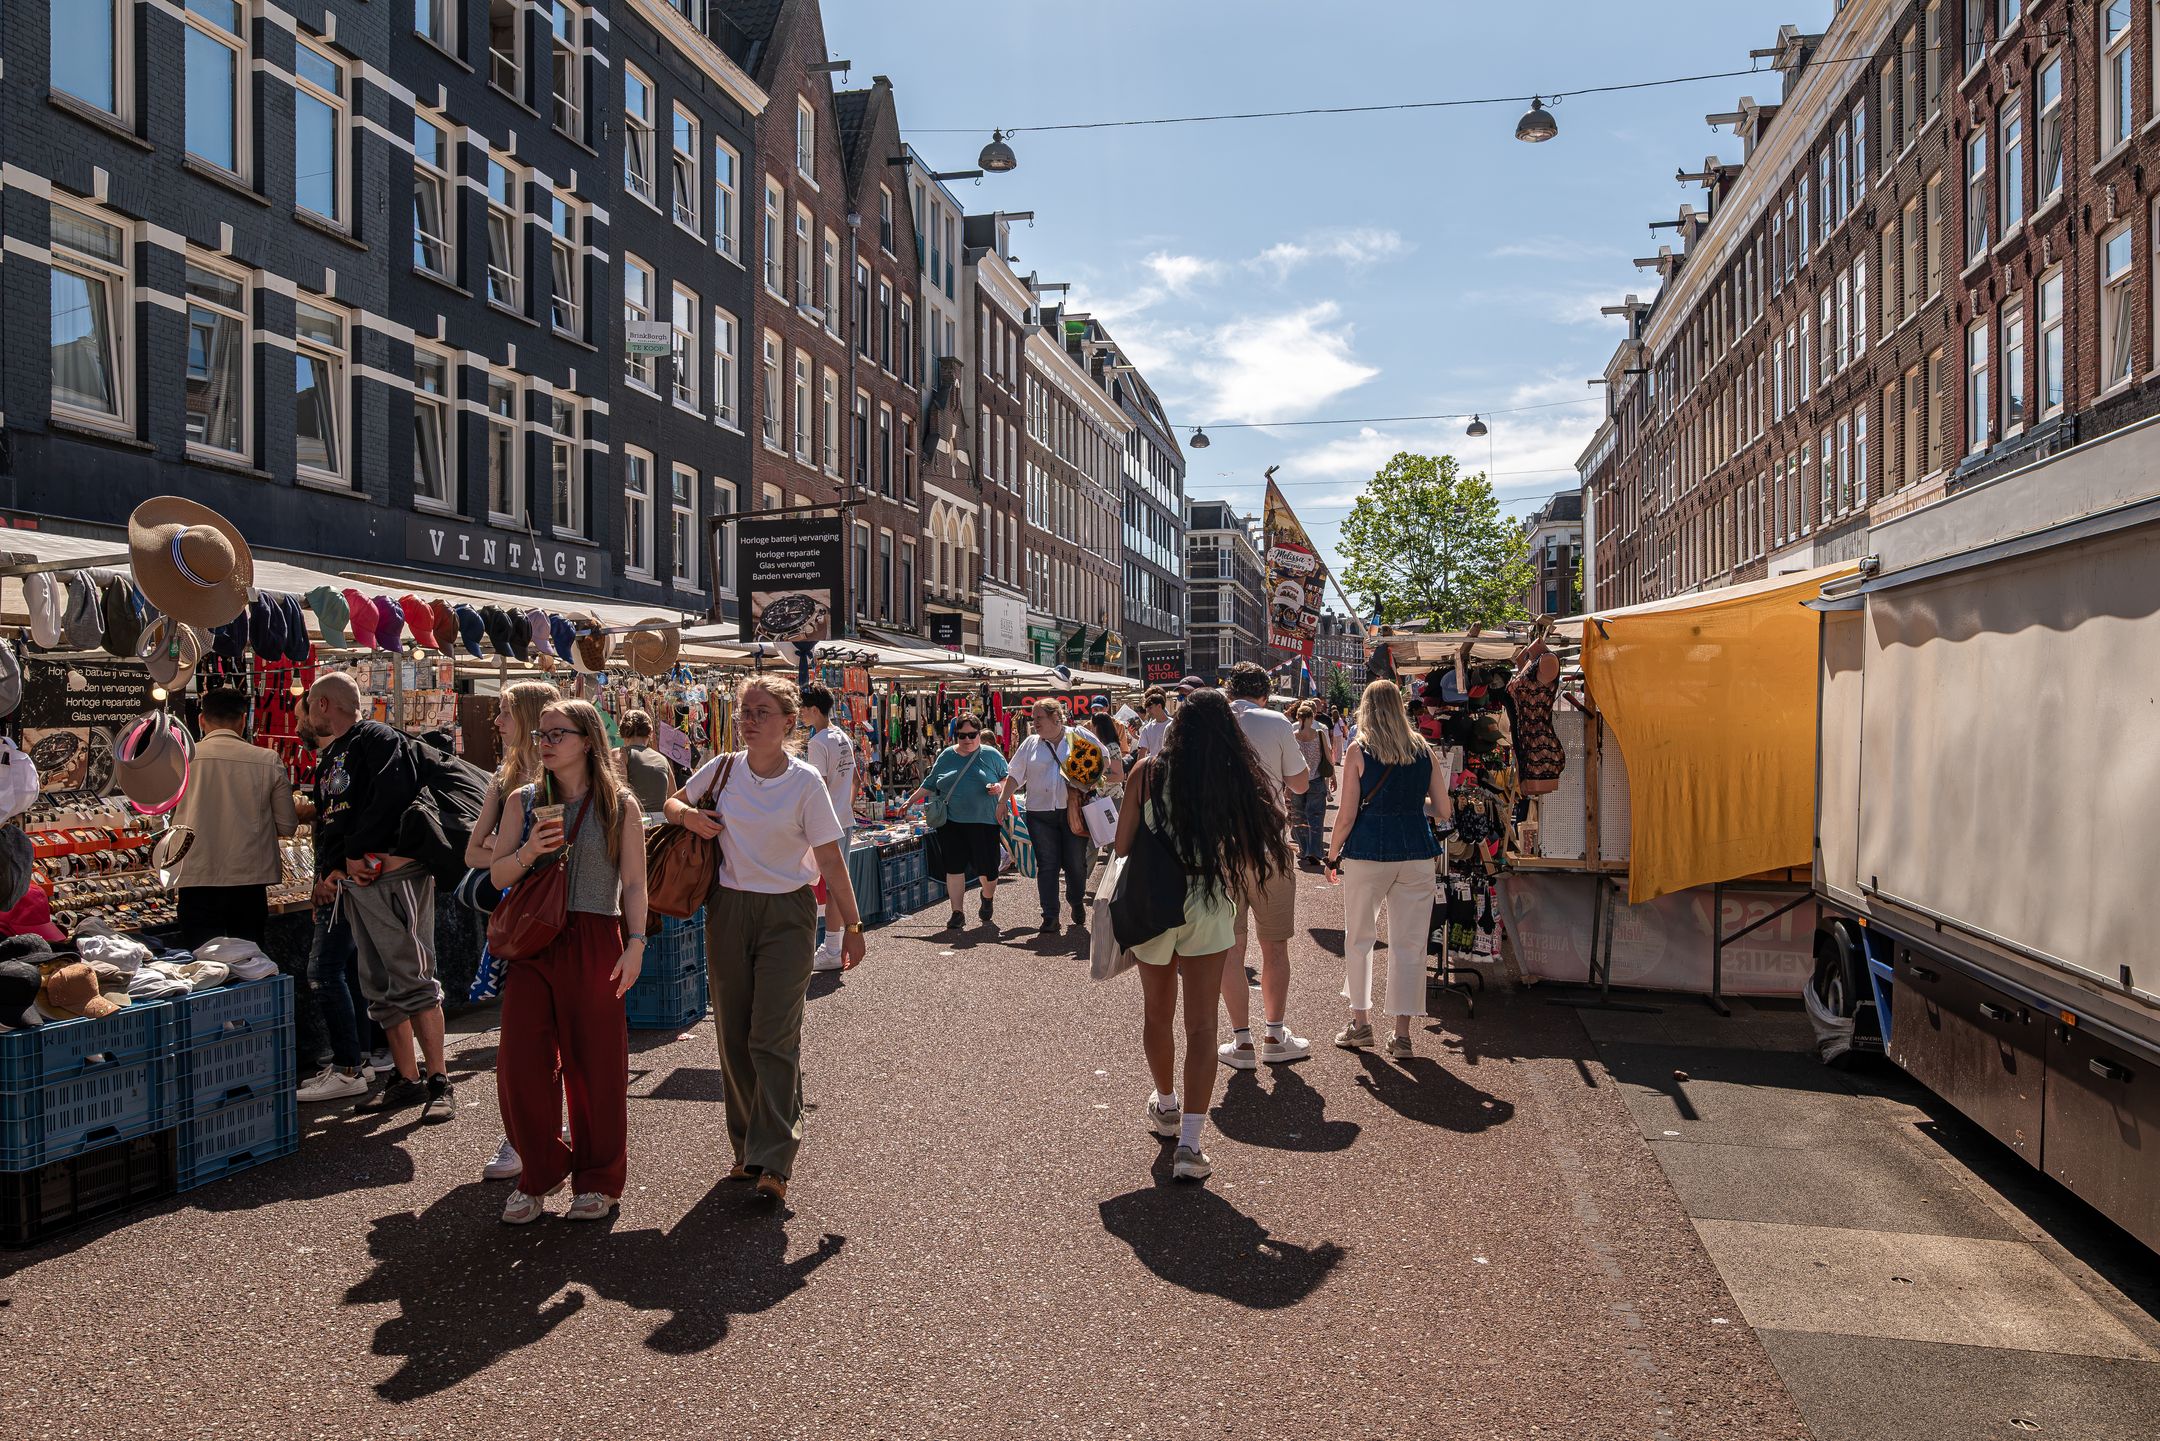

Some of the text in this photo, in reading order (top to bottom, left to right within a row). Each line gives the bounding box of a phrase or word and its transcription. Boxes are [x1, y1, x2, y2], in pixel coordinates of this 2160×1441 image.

[630, 332, 667, 340] BrinkBorgh
[740, 533, 839, 545] Horloge batterij vervanging
[429, 529, 587, 579] VINTAGE
[755, 549, 820, 559] Horloge reparatie
[777, 561, 815, 569] vervangen
[782, 571, 821, 580] vervangen
[48, 667, 83, 676] Hore
[1147, 663, 1171, 672] KILO
[1148, 671, 1180, 680] STORE
[66, 684, 145, 694] Bden vervangen
[66, 698, 141, 708] Horloge reparatie
[71, 712, 91, 721] Glas
